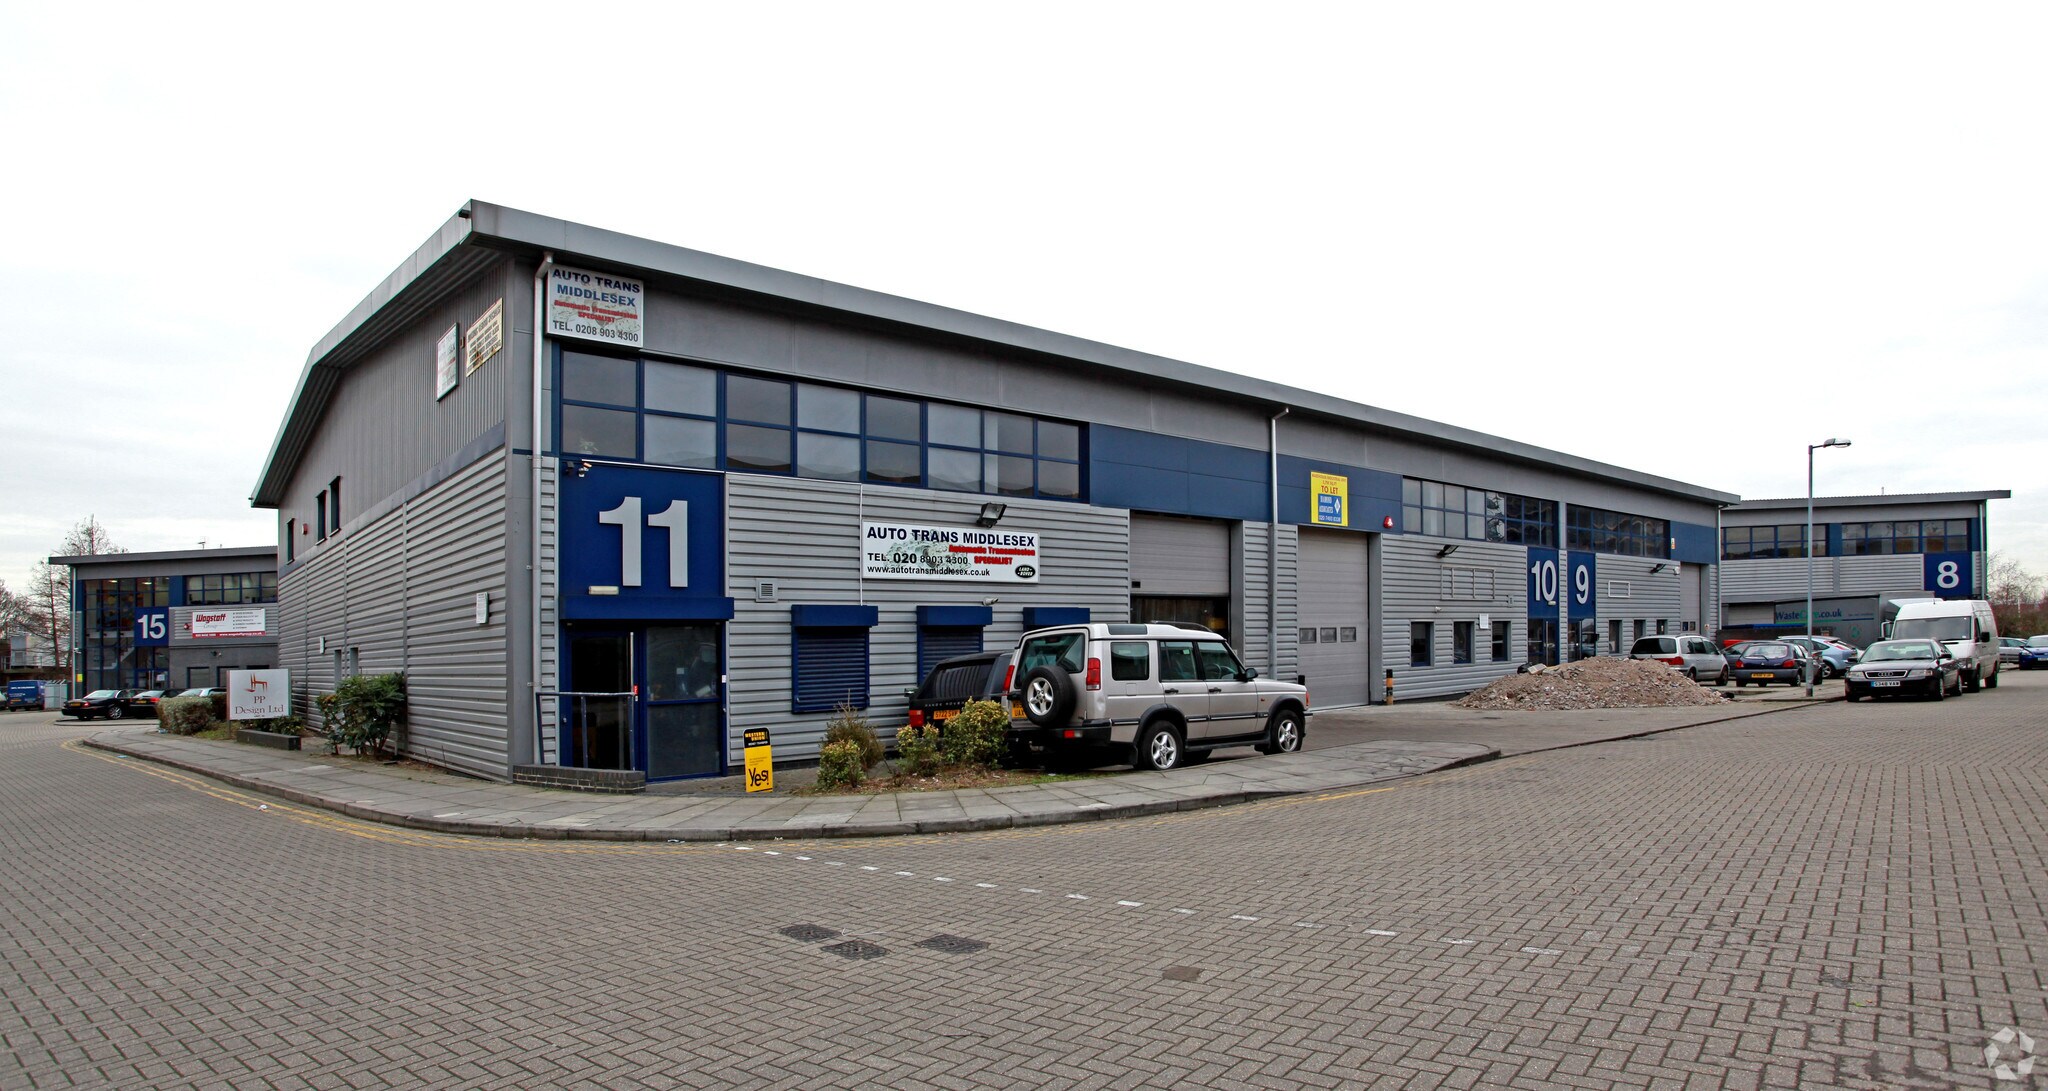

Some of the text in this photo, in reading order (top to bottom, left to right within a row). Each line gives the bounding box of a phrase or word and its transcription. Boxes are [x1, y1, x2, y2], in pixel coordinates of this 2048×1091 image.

[553, 269, 640, 293] AUTO TRANS
[557, 284, 636, 307] MIDDLESEX
[578, 311, 615, 323] SPECIALIST
[553, 320, 638, 342] TEL. 0208 903 4300
[1321, 485, 1338, 494] TO LET
[599, 496, 688, 587] 11
[867, 526, 1034, 547] AUTO TRANS MIDDLESEX
[868, 552, 968, 565] TEL. 020 8903 4300
[974, 556, 1013, 565] SPECIALIST
[867, 565, 990, 576] www.autotransmiddlesex.co.uk
[1531, 560, 1557, 601] 10
[1936, 561, 1959, 589] 8
[1575, 564, 1589, 604] 9
[196, 613, 227, 624] Wagstaff
[1775, 608, 1842, 620] WasteCe.co.uk
[137, 613, 166, 639] 15
[235, 704, 284, 714] Design Ltd
[254, 695, 266, 704] PP
[748, 767, 769, 787] Yes!
